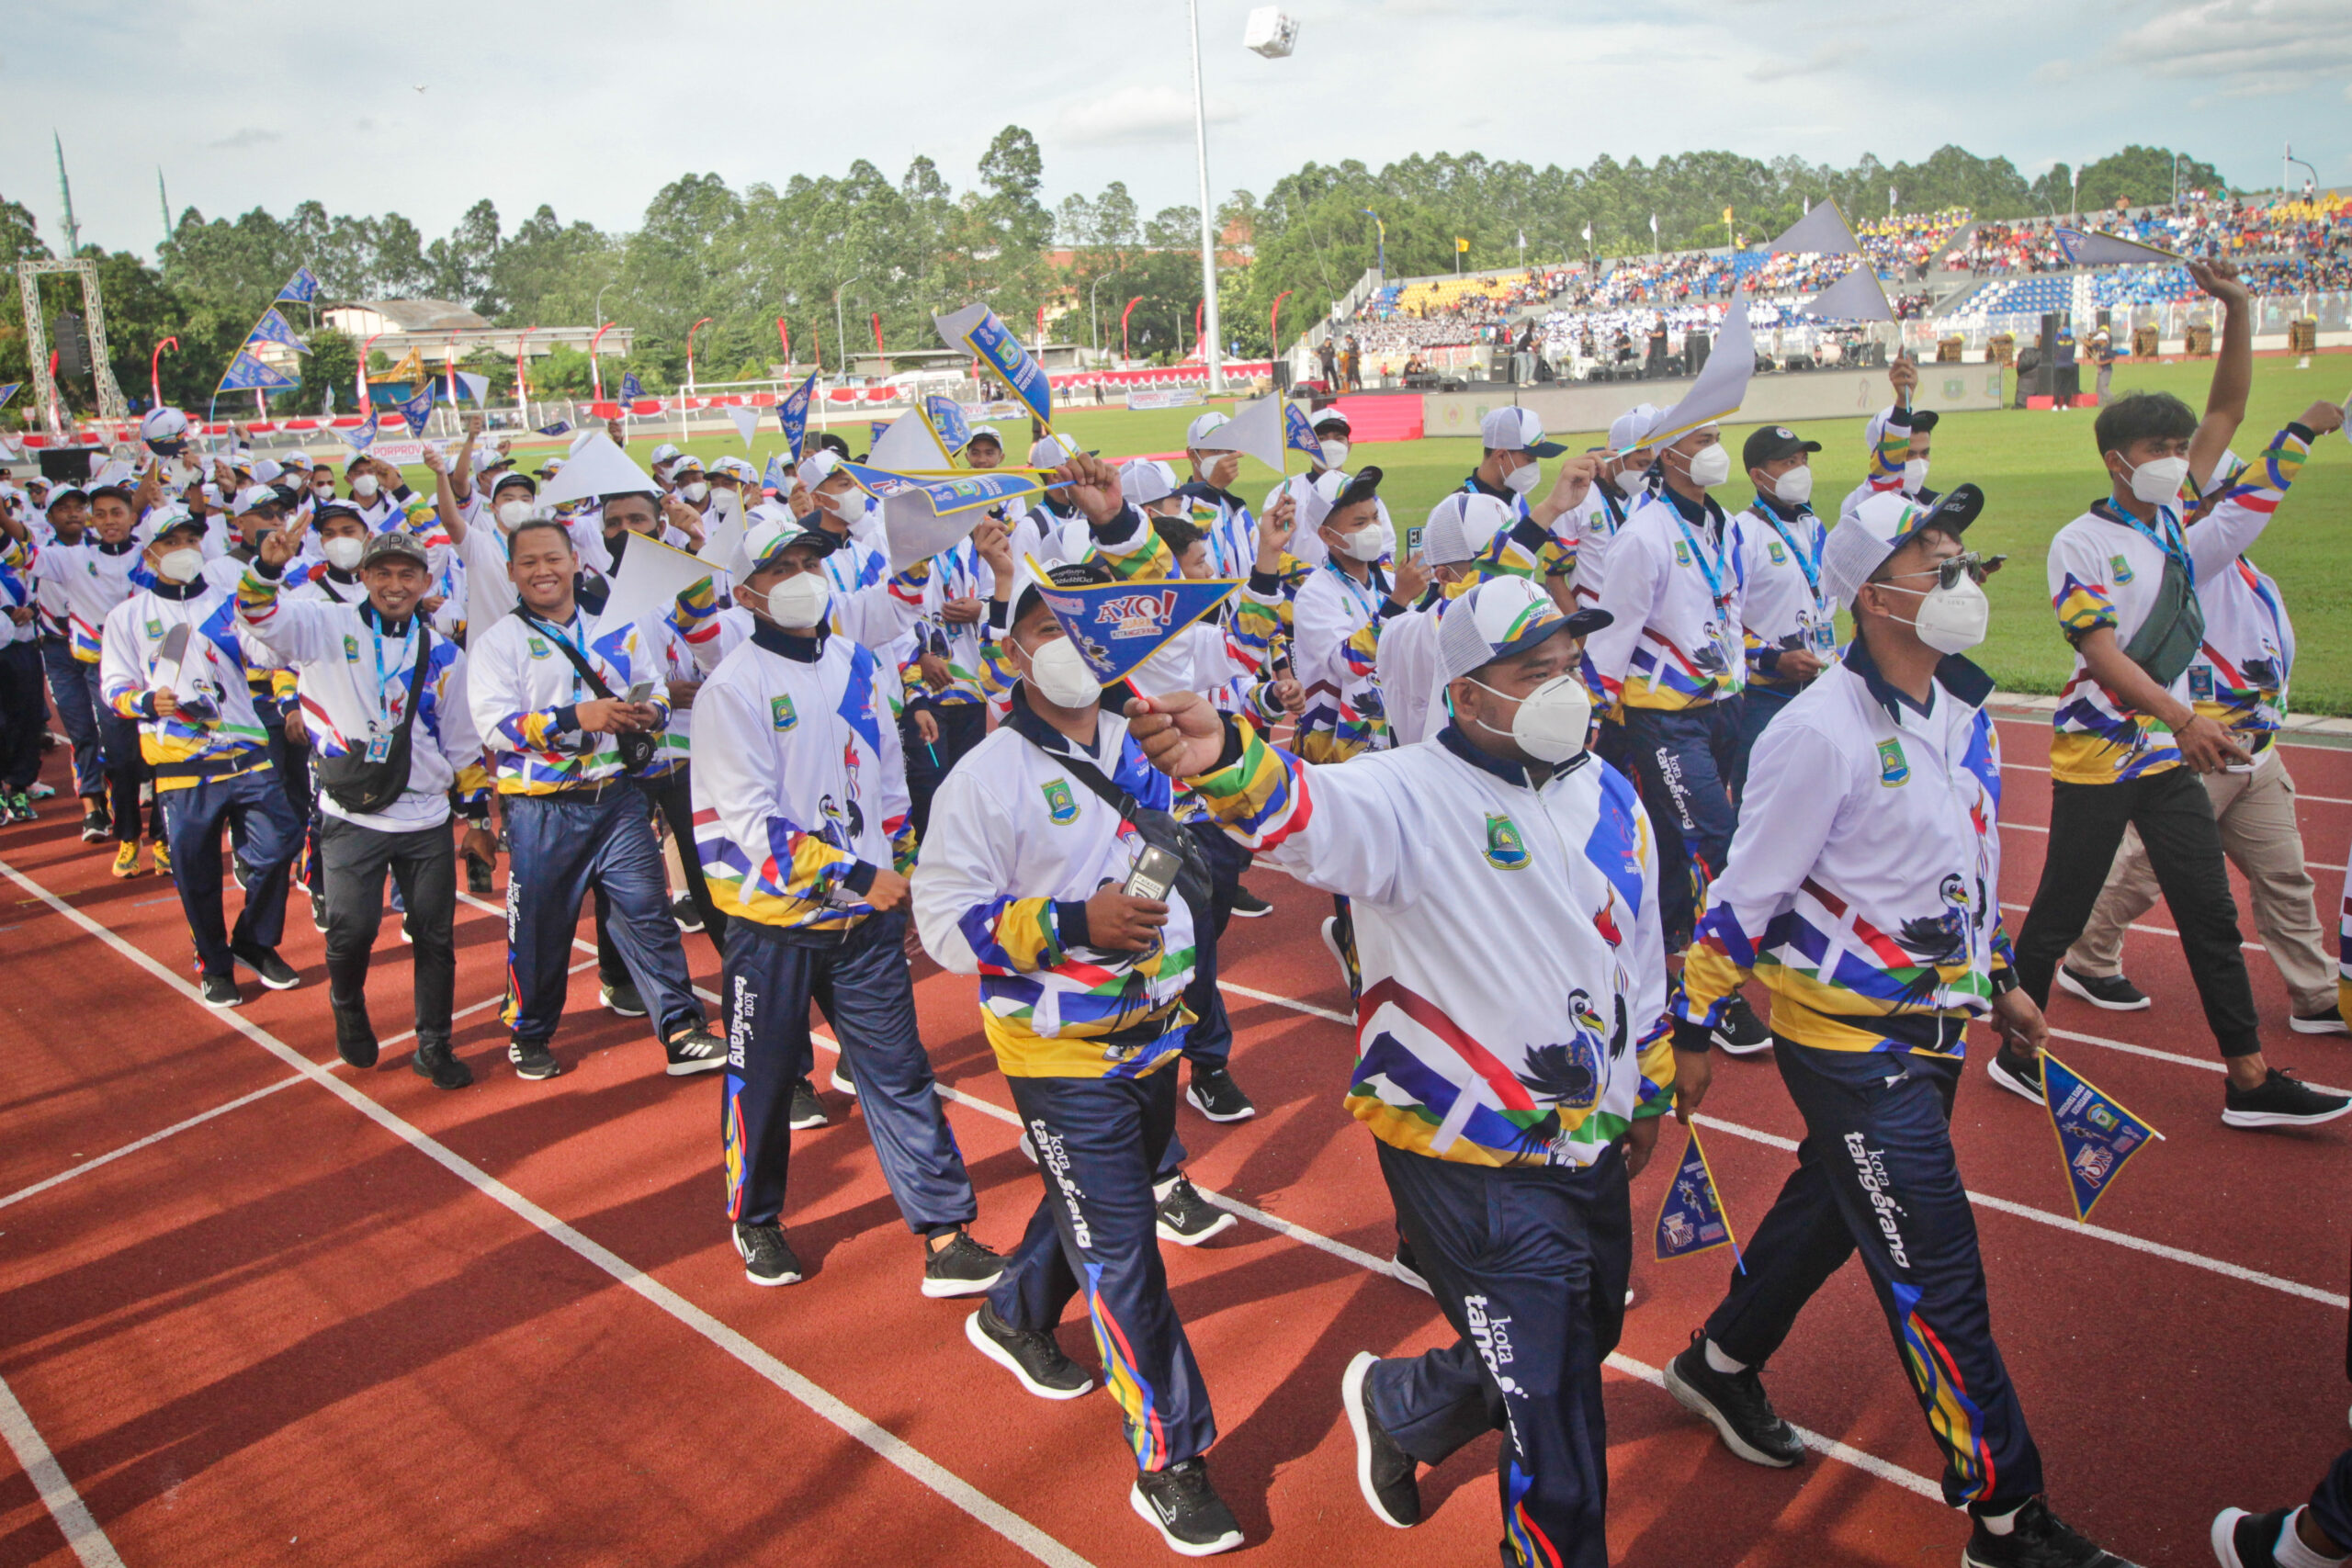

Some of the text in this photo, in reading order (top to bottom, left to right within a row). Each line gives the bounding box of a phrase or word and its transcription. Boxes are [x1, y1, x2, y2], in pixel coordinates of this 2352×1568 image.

[373, 445, 421, 457] PORPROV
[389, 535, 404, 549] P
[1094, 589, 1179, 626] AYO!
[1118, 618, 1155, 630] JUARA
[1668, 754, 1682, 780] kota
[1656, 747, 1695, 830] tangerang
[729, 975, 750, 1069] tangerang
[744, 991, 758, 1018] kota
[1049, 1134, 1071, 1171] kota
[1867, 1149, 1890, 1187] kota
[1030, 1119, 1092, 1249] tangerang
[1844, 1132, 1911, 1269] tangerang
[1489, 1315, 1514, 1365] kota
